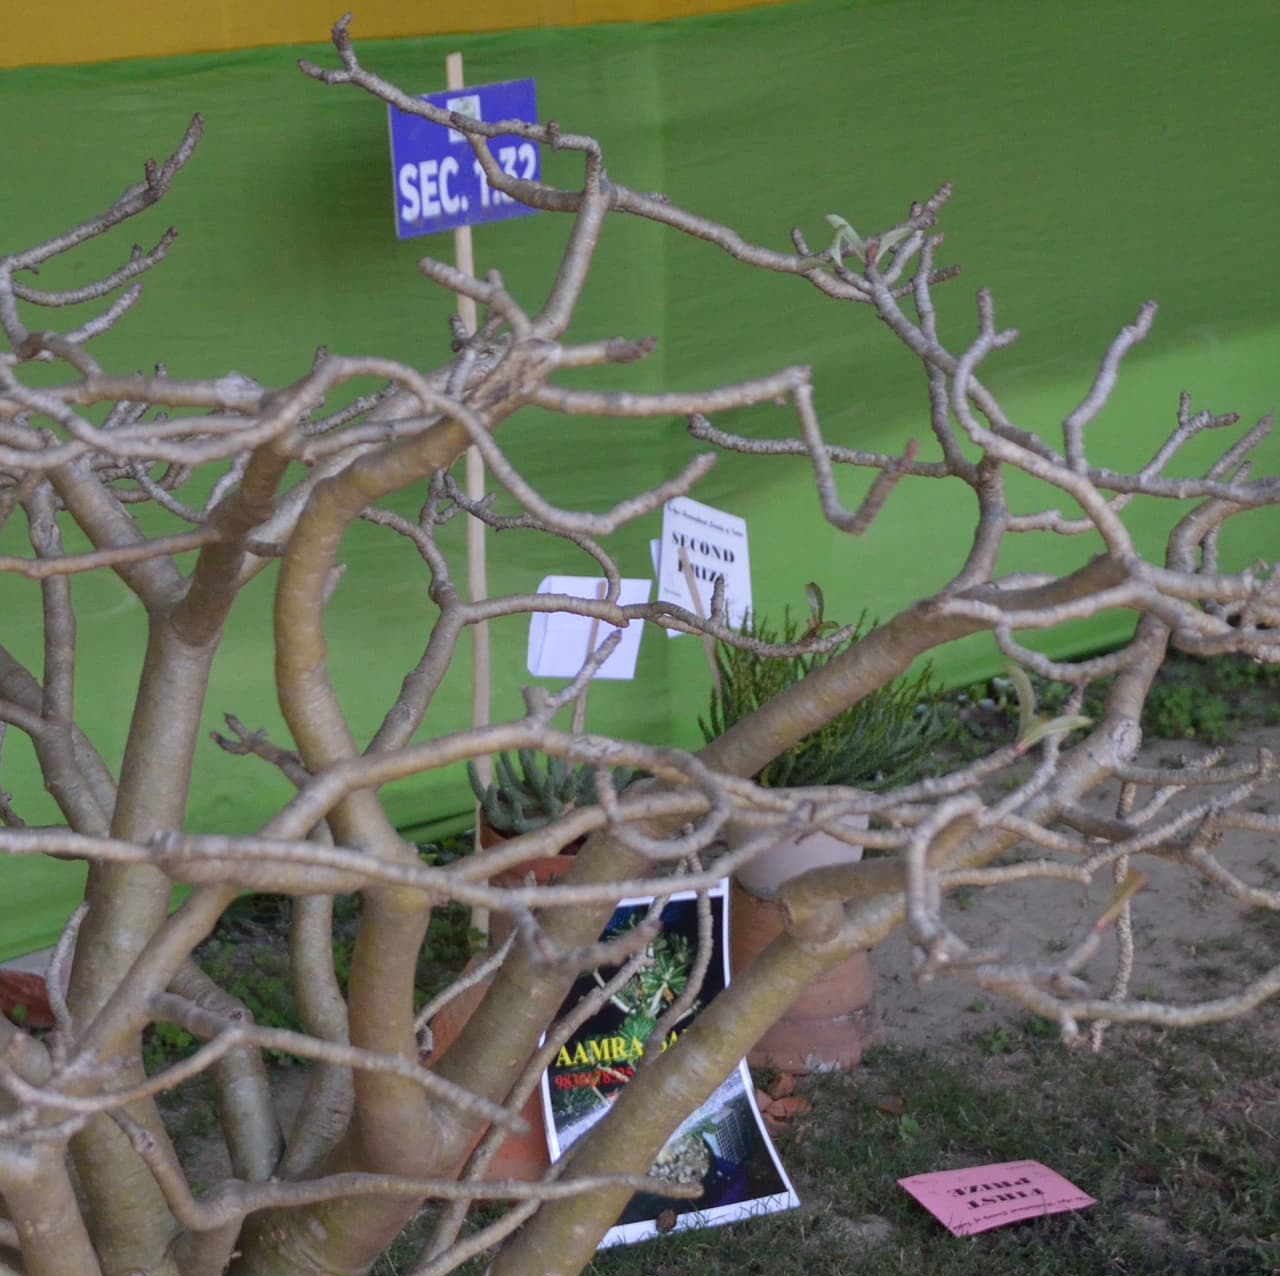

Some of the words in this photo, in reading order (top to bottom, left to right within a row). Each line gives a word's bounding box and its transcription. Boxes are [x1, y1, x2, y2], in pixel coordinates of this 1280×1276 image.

[398, 156, 469, 223] SEC.
[672, 530, 735, 563] SECOND
[555, 1034, 645, 1067] AAMRA
